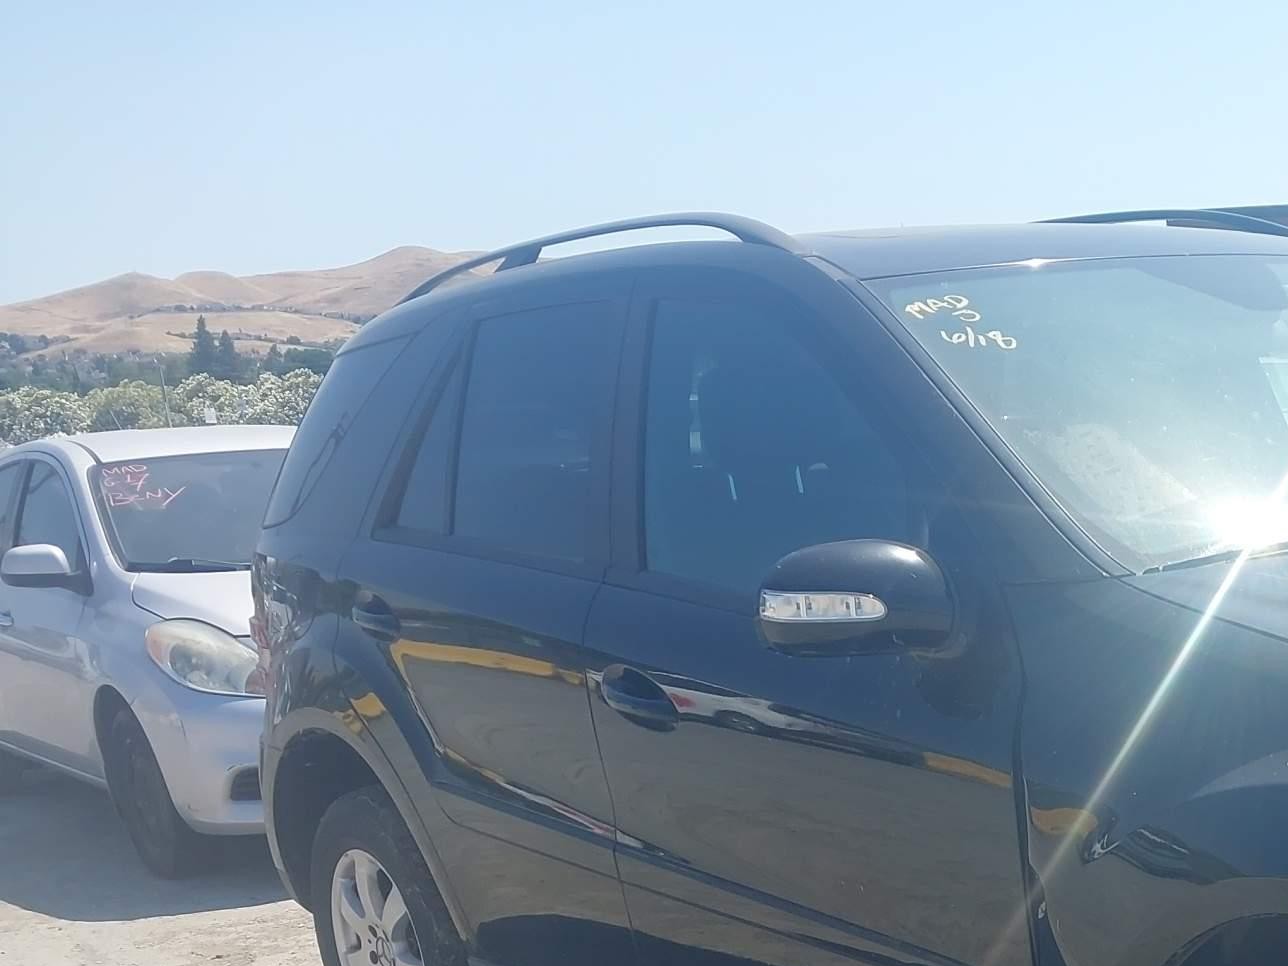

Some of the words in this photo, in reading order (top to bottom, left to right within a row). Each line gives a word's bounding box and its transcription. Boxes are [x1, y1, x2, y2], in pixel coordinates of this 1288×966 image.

[904, 294, 969, 320] MAD
[940, 326, 1017, 350] 6/18
[102, 464, 148, 477] MAD
